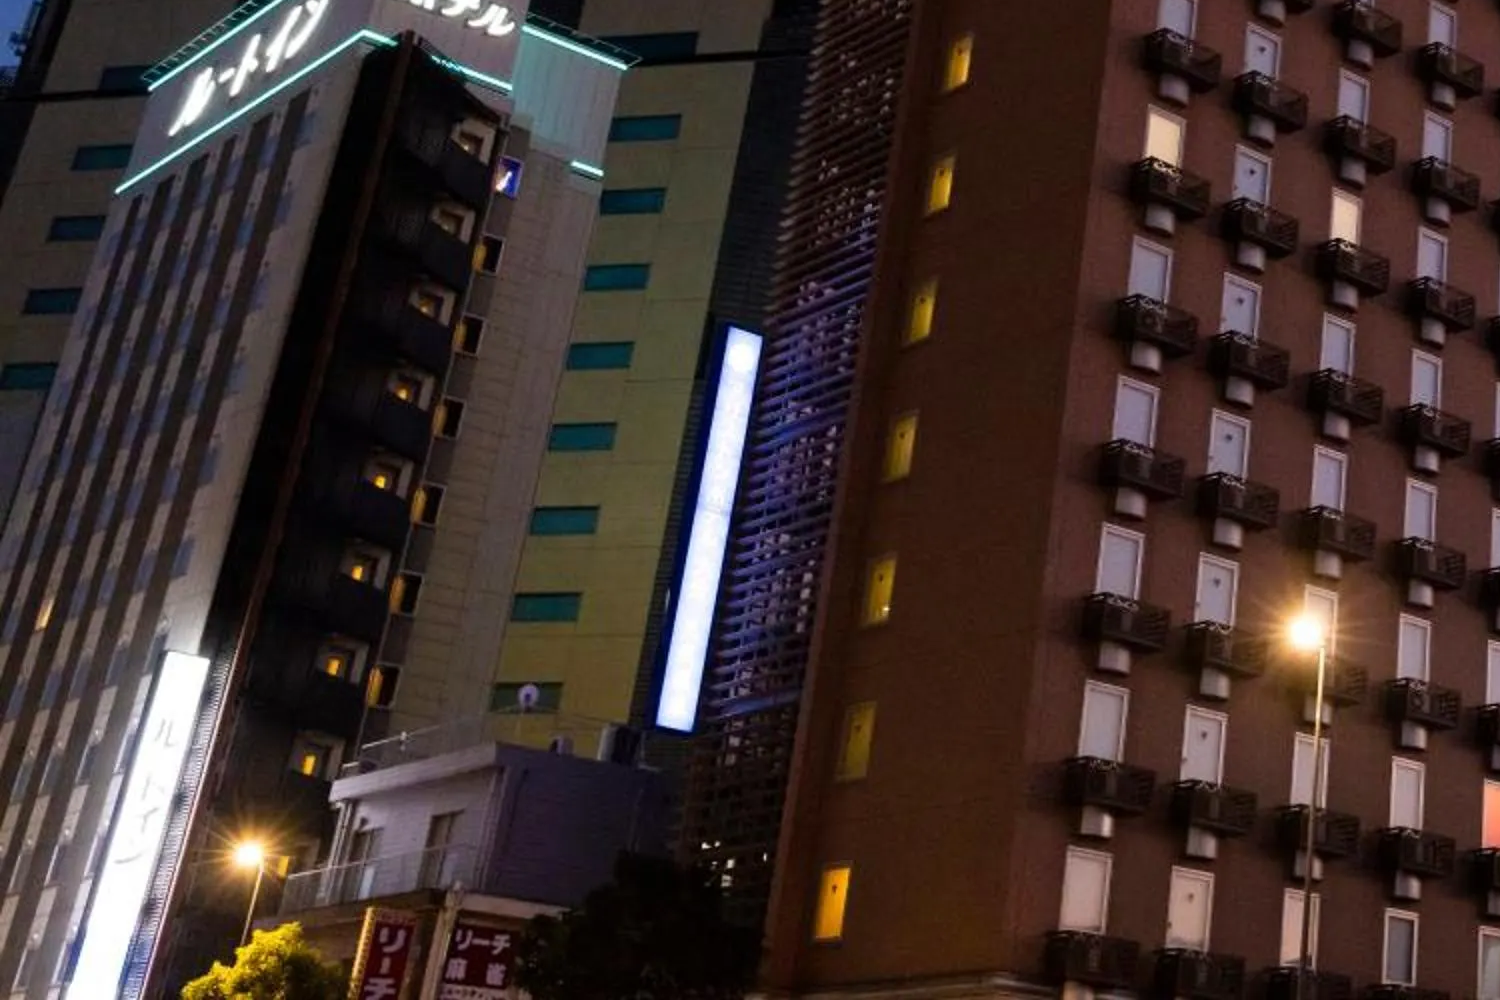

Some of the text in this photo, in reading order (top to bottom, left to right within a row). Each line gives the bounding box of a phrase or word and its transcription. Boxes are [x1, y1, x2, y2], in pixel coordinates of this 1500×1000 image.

[113, 717, 179, 866] ルトイン
[455, 928, 511, 956] リーチ
